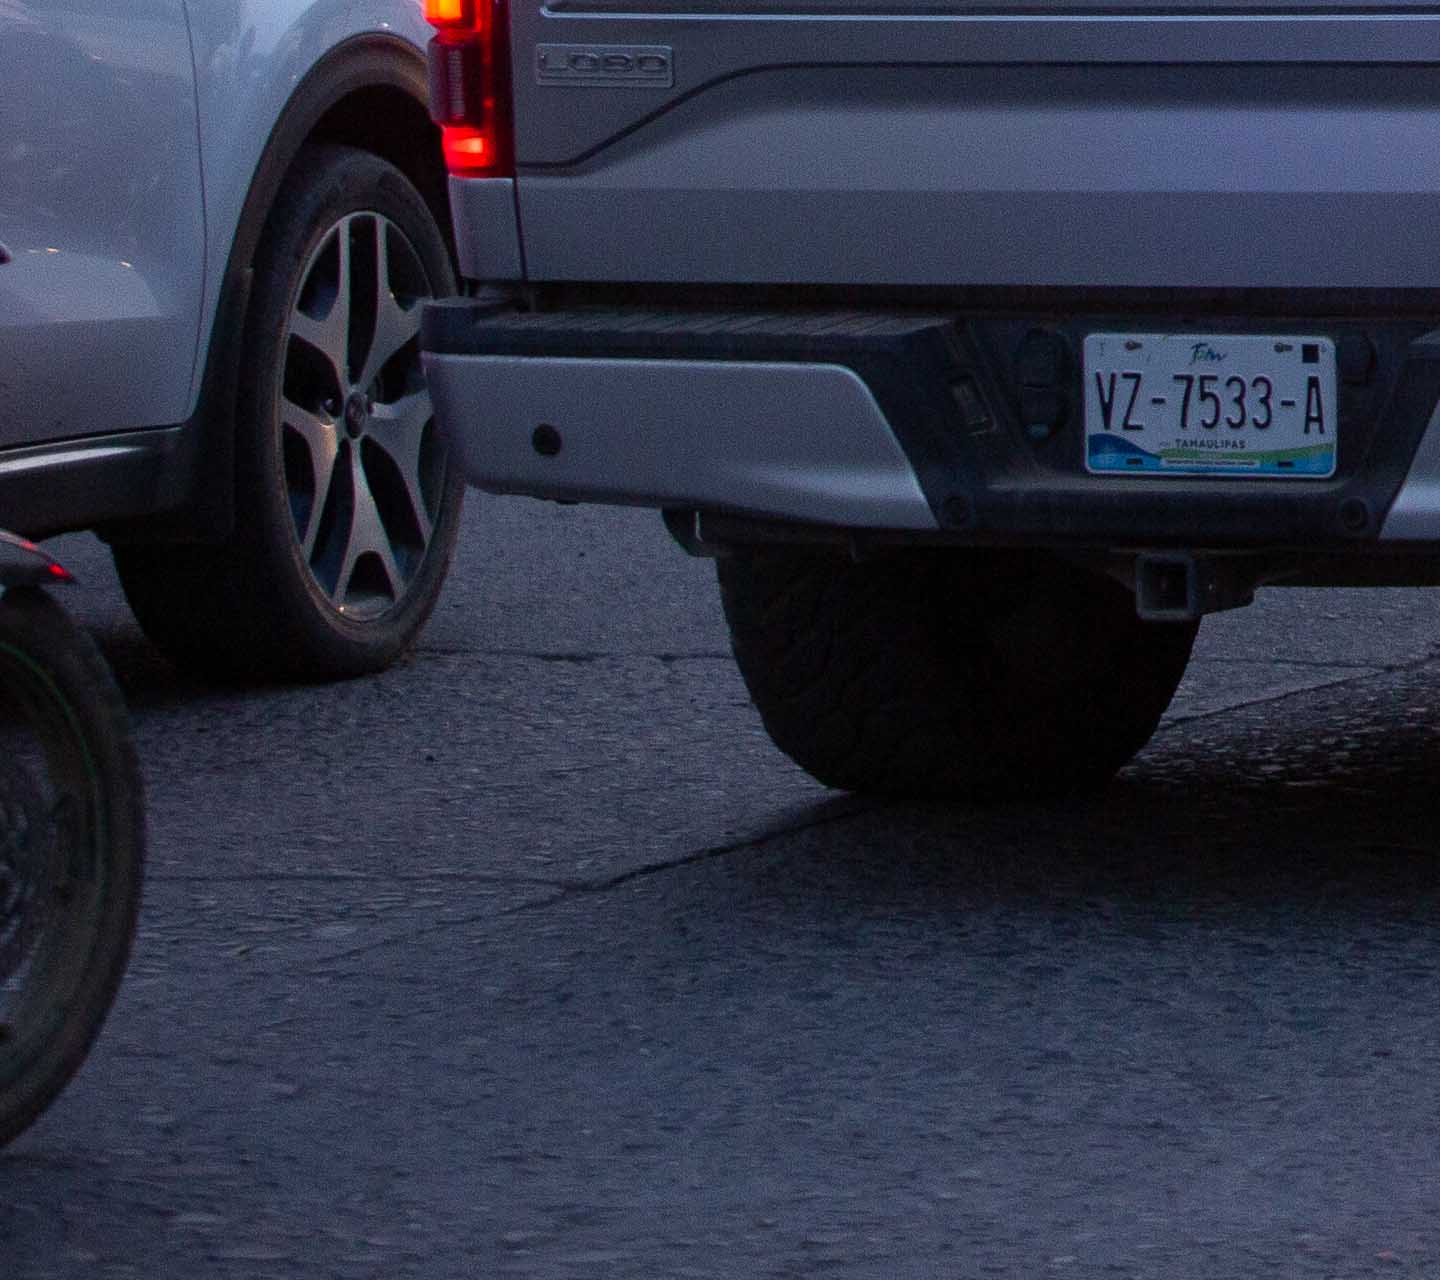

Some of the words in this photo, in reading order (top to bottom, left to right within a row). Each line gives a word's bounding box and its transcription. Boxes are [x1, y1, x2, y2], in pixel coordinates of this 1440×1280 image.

[539, 51, 669, 73] LOBO
[1095, 370, 1325, 435] VZ-7533-A
[1174, 438, 1246, 450] TAMAULIPAS
